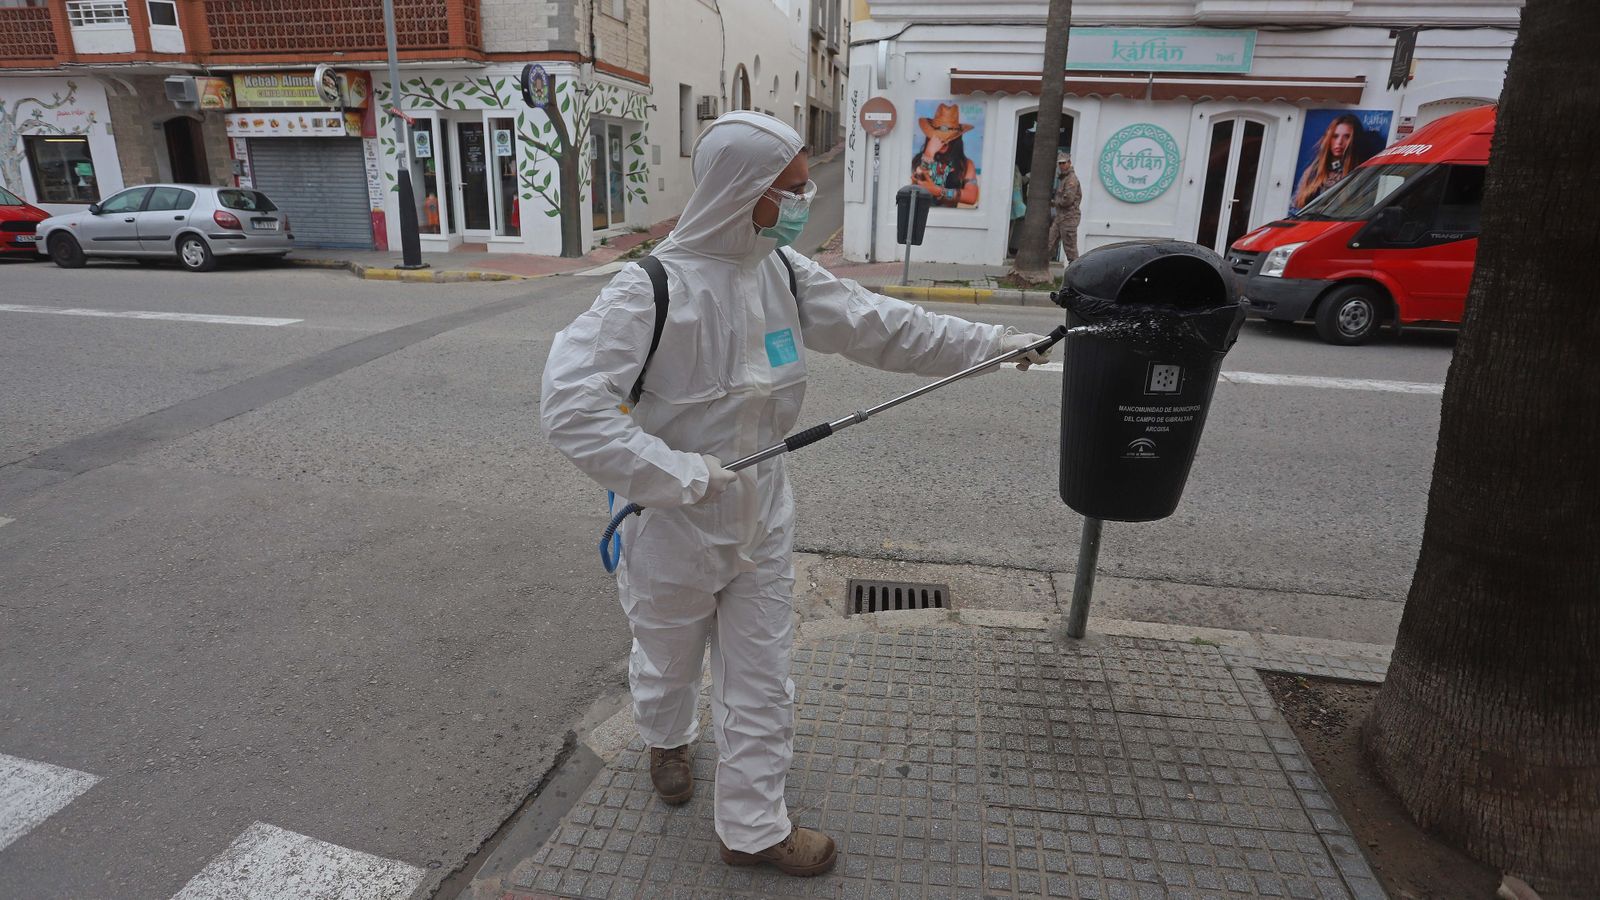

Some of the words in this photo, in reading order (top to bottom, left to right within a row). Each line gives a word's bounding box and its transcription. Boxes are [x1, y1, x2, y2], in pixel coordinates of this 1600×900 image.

[244, 76, 278, 88] Kebab
[1118, 404, 1163, 413] MANCOMUNIDAD
[1173, 404, 1201, 413] MUNICIPIOS
